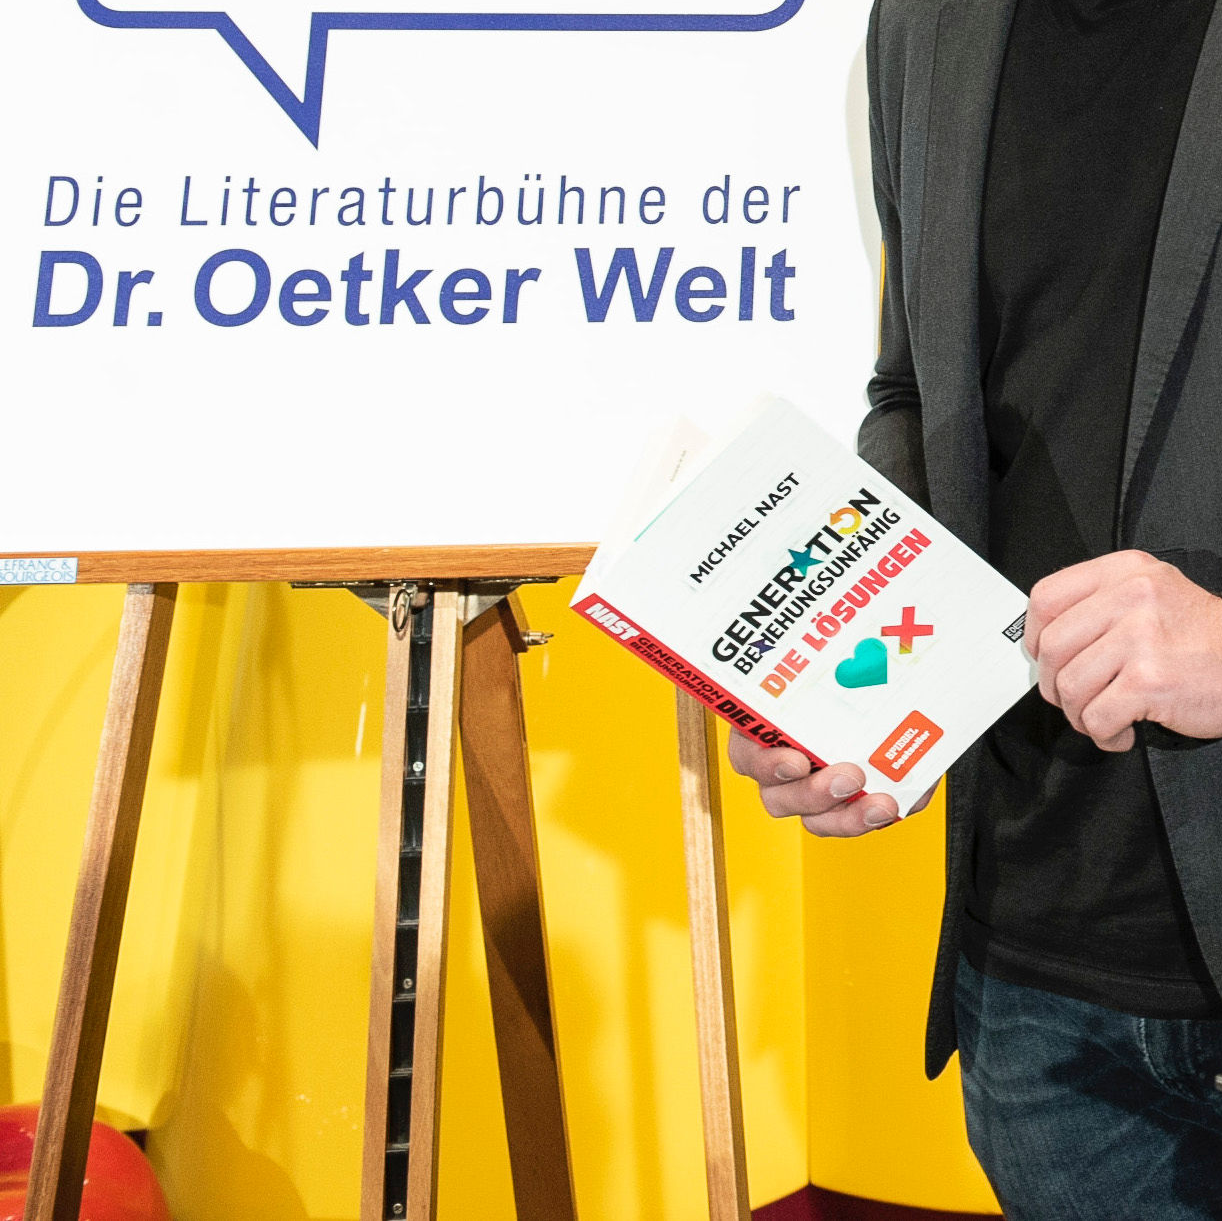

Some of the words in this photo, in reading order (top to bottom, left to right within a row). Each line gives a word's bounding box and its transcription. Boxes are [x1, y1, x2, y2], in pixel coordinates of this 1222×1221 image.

[44, 176, 144, 228] Die
[180, 175, 667, 227] Literaturbühne
[702, 175, 801, 225] der
[32, 249, 163, 328] Dr.
[193, 248, 541, 327] Oetker
[573, 246, 797, 323] Welt
[0, 559, 57, 571] EFRANC
[690, 517, 760, 584] MICHAEL
[756, 472, 801, 517] NAST
[759, 647, 811, 699] DIE
[801, 527, 933, 653] LÖSUNGEN
[583, 602, 642, 642] NAST
[637, 636, 725, 701] GENERATION
[714, 698, 757, 729] DIE
